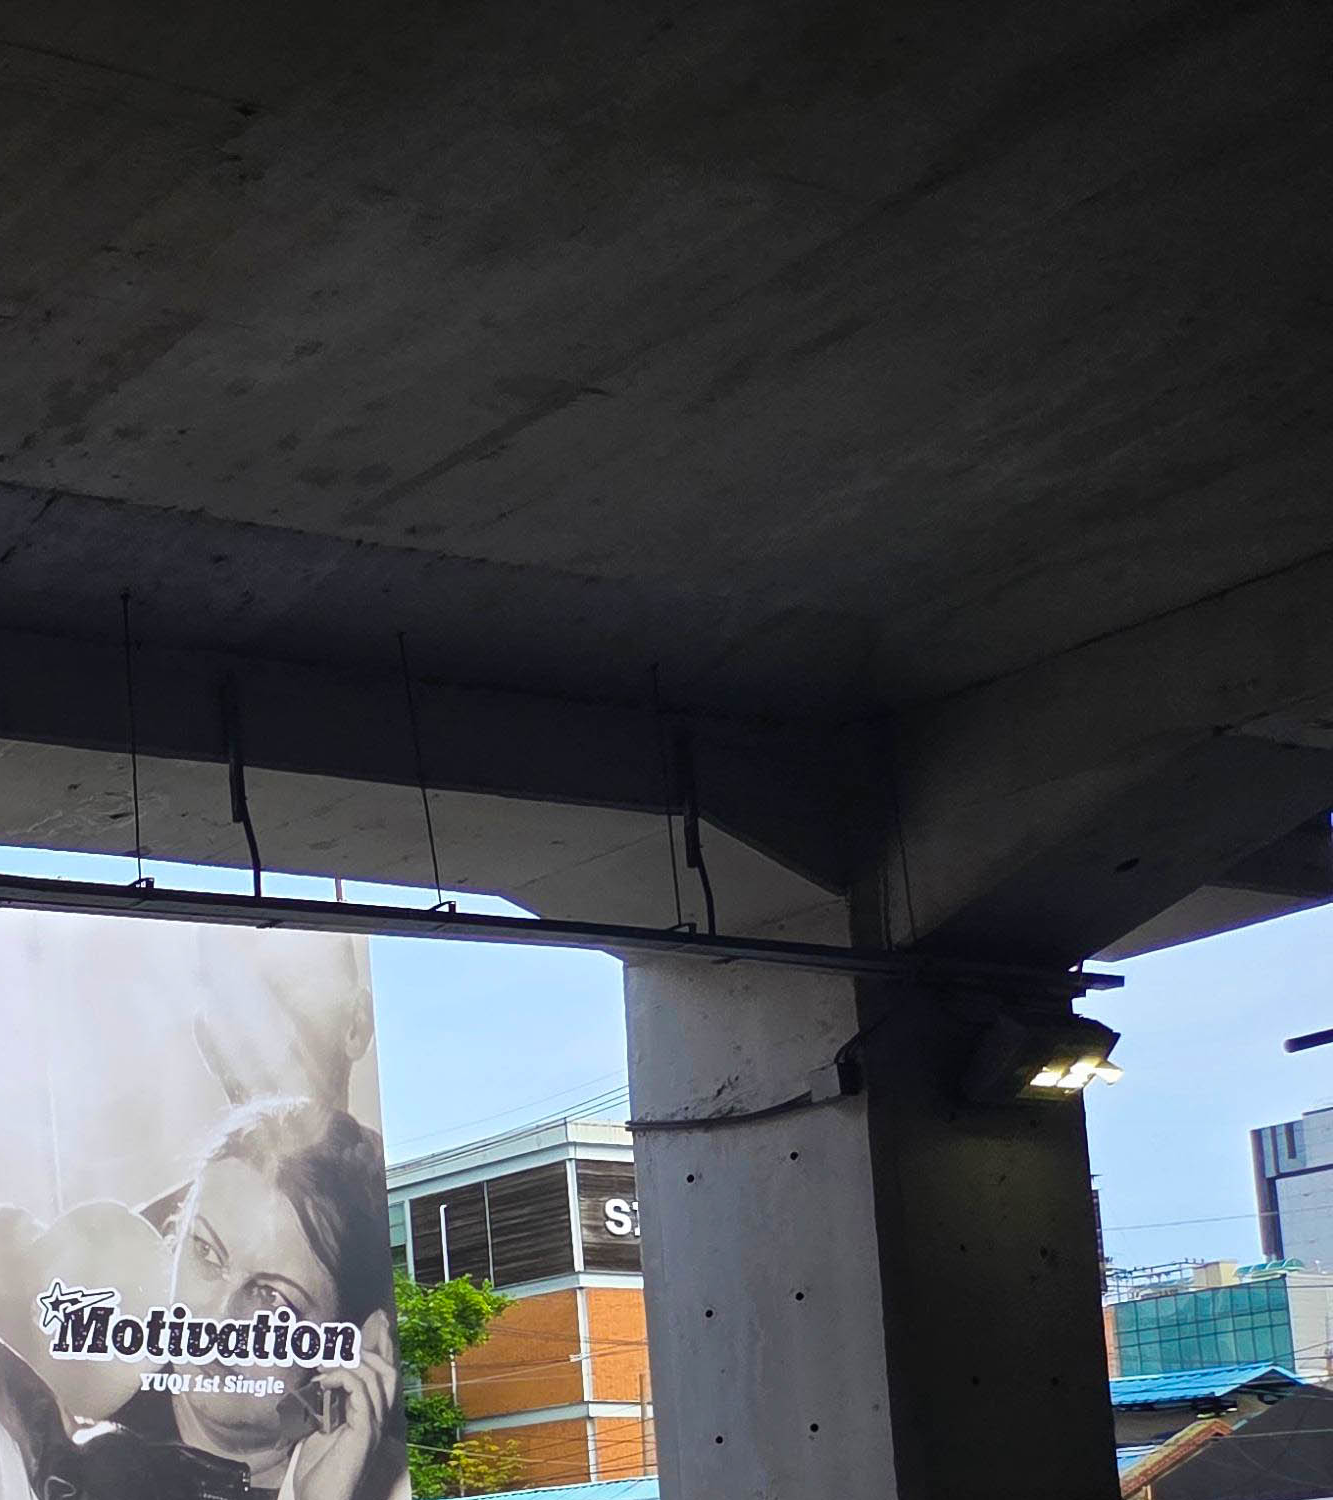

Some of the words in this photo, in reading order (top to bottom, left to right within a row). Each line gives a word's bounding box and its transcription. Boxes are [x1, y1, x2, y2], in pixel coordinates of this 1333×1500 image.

[50, 1304, 358, 1363] Motivation
[139, 1372, 191, 1393] YUQI
[193, 1373, 220, 1394] 1st
[223, 1374, 285, 1398] Single
